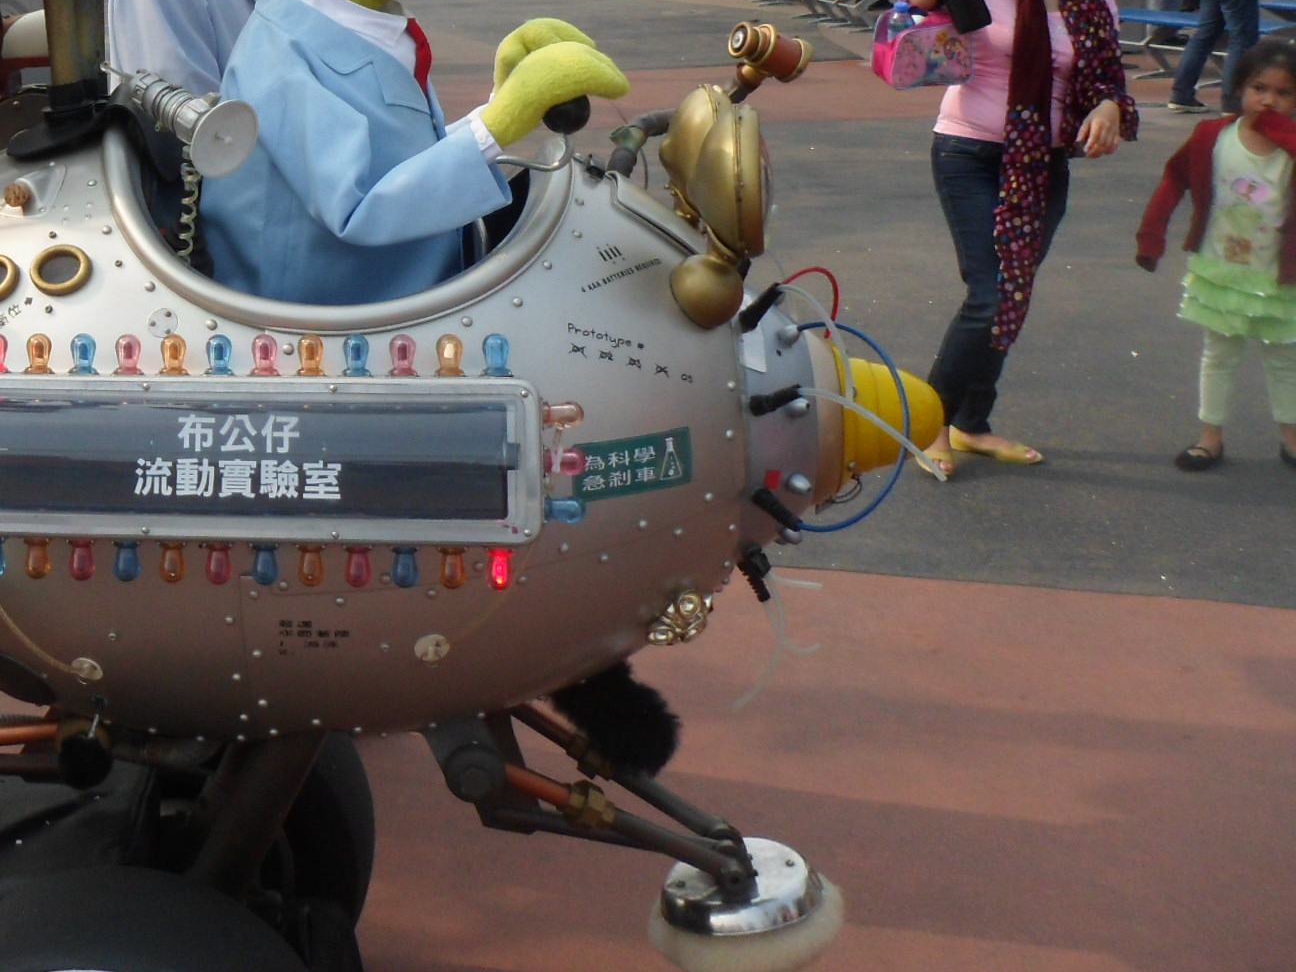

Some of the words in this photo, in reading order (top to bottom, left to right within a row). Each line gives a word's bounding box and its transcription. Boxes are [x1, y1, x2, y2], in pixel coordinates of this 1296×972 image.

[587, 280, 602, 291] AAA
[601, 267, 635, 285] BATTERIES
[634, 258, 662, 272] REQUIRED
[567, 322, 633, 348] Prototype
[177, 413, 301, 454] 布公仔
[585, 445, 656, 472] 為科學
[134, 456, 343, 501] 流動實驗室
